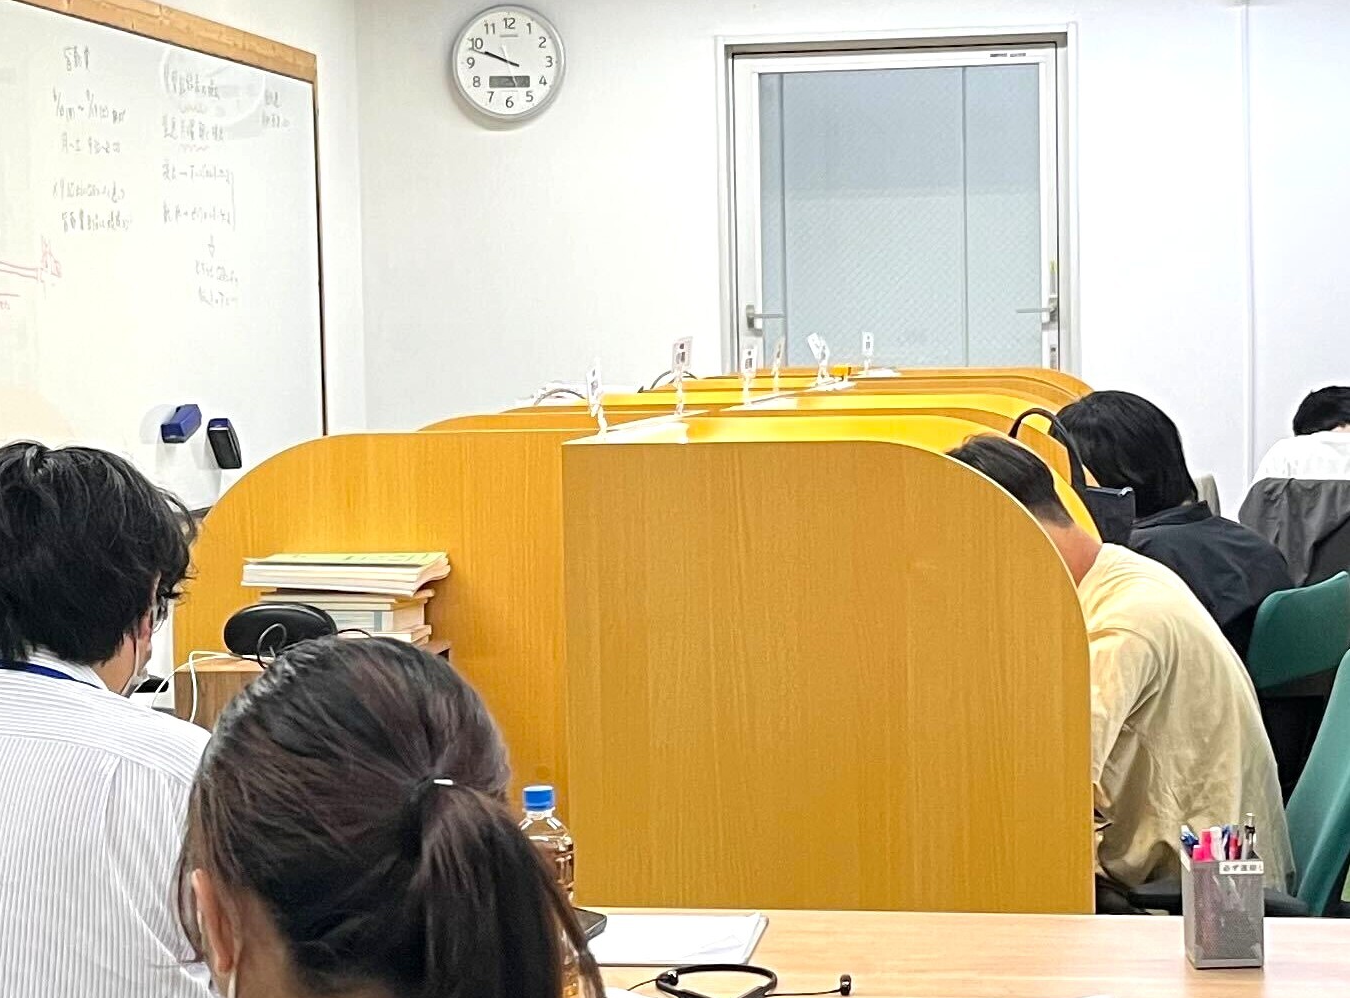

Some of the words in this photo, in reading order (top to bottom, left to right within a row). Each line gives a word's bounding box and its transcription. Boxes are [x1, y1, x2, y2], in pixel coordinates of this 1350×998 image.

[483, 22, 496, 35] 11
[503, 17, 516, 30] 12
[526, 22, 532, 35] 1
[468, 37, 484, 50] 10
[538, 36, 547, 49] 2
[466, 56, 476, 69] 9
[545, 55, 554, 68] 3
[472, 75, 481, 88] 8
[538, 75, 548, 87] 4
[487, 91, 495, 103] 7
[505, 95, 514, 109] 6
[525, 90, 534, 103] 5
